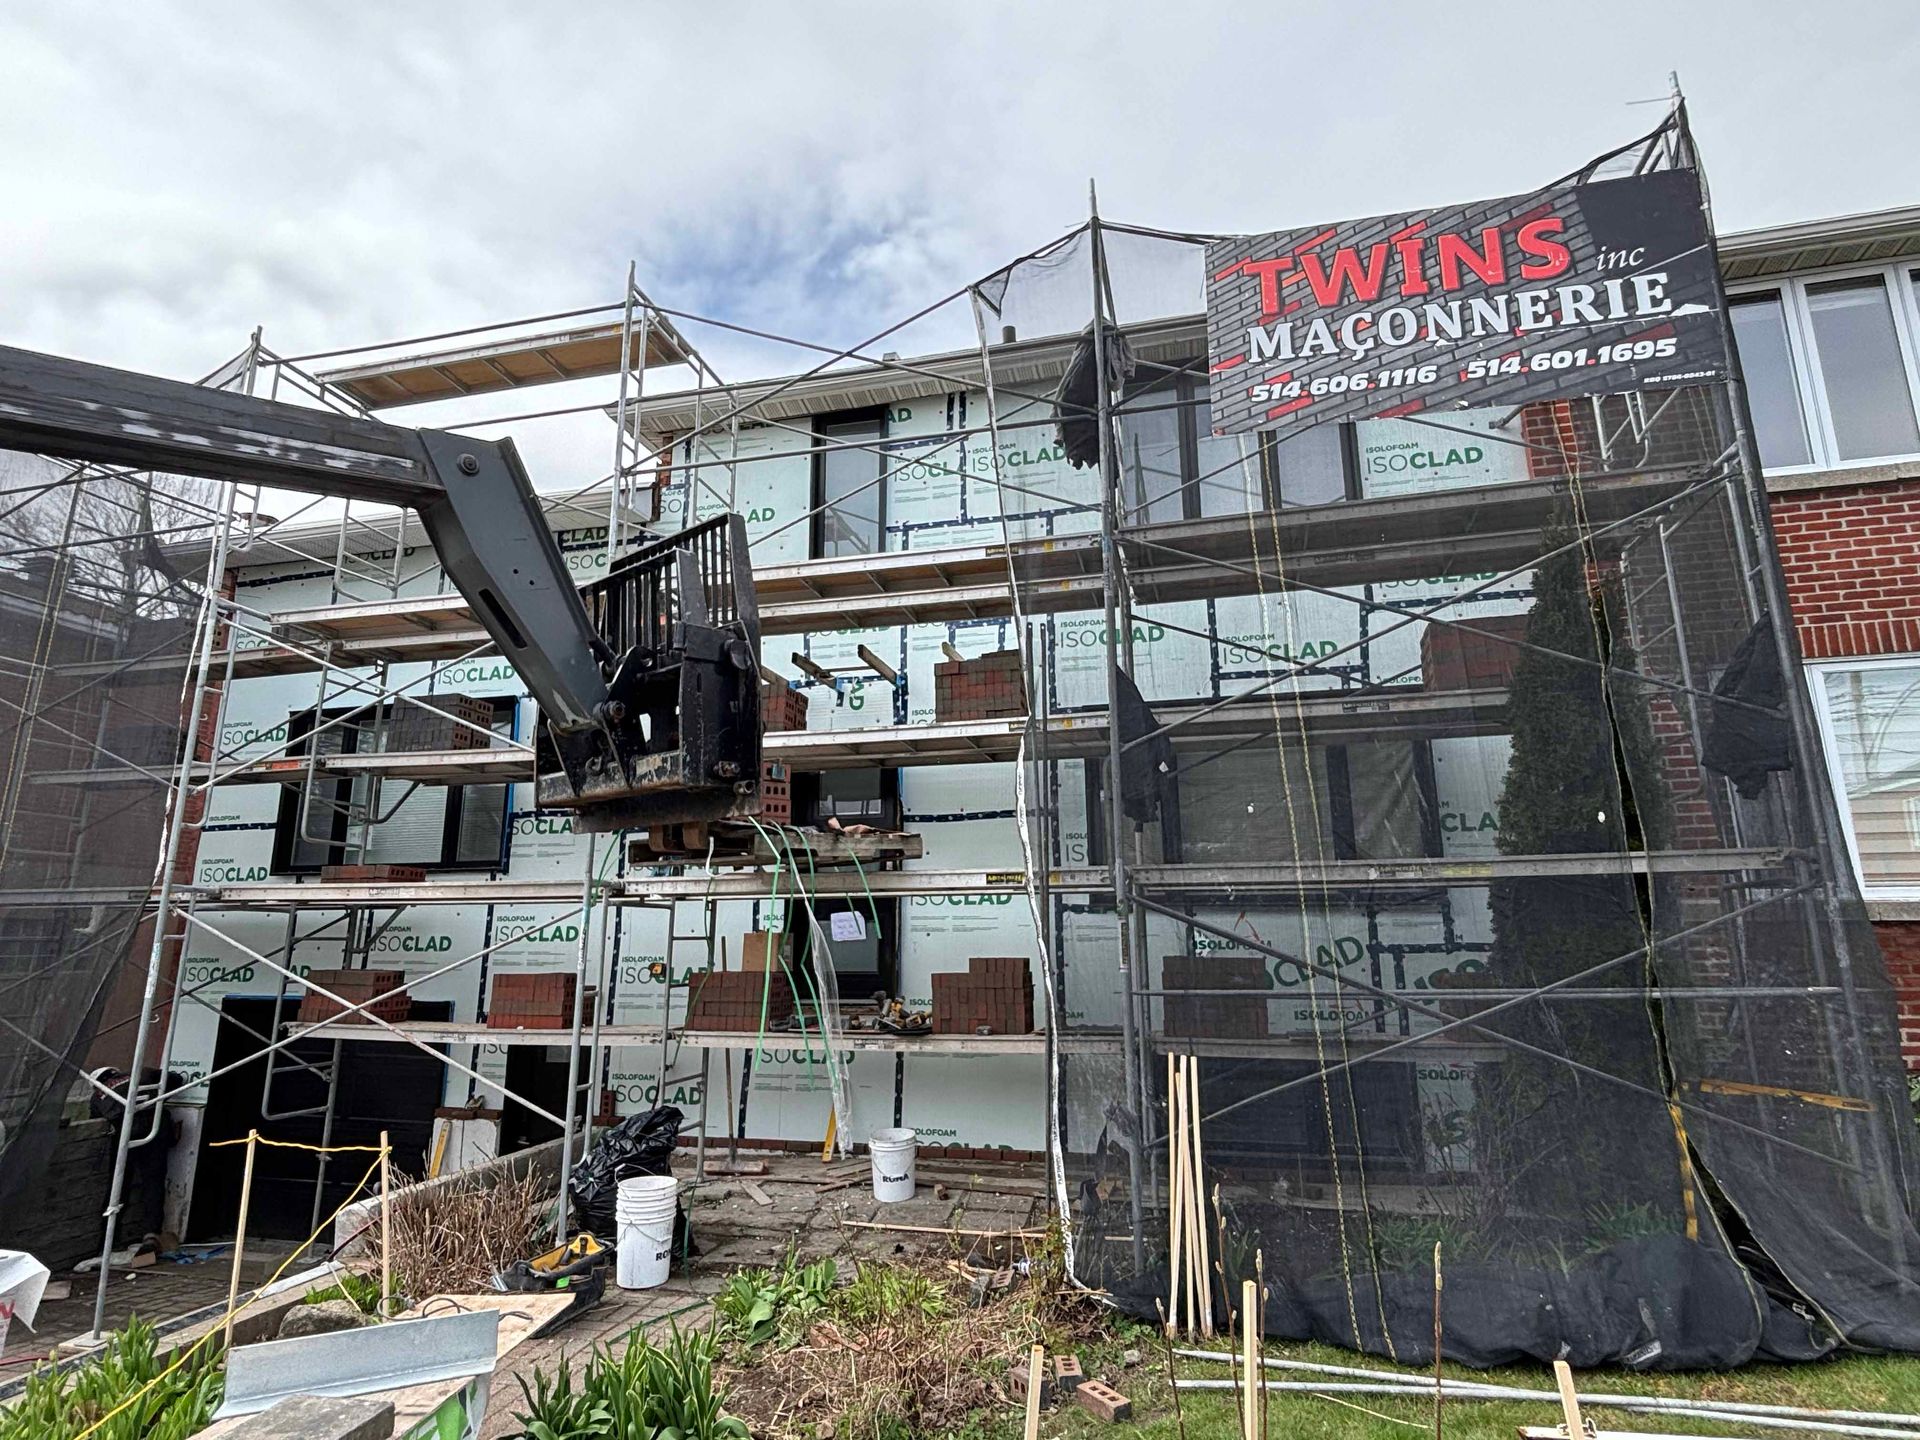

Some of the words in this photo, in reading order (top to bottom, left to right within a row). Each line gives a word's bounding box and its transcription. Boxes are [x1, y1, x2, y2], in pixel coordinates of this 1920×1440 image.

[1243, 217, 1571, 316] TWINS
[1596, 245, 1645, 271] inc
[1246, 272, 1672, 363] MAÇONNERIE
[1251, 365, 1437, 402] 514.606.1116
[1466, 337, 1677, 379] 514.601.1695
[1366, 442, 1418, 454] ISOLOFOAM
[1366, 446, 1483, 474] ISOCLAD
[438, 665, 515, 685] ISOCLAD
[223, 727, 286, 745] SOCLAD
[512, 818, 573, 835] SOCLA
[199, 866, 268, 883] ISOCLAD
[494, 925, 579, 943] ISOCLAD
[612, 1073, 655, 1081] ISOLOFOAM
